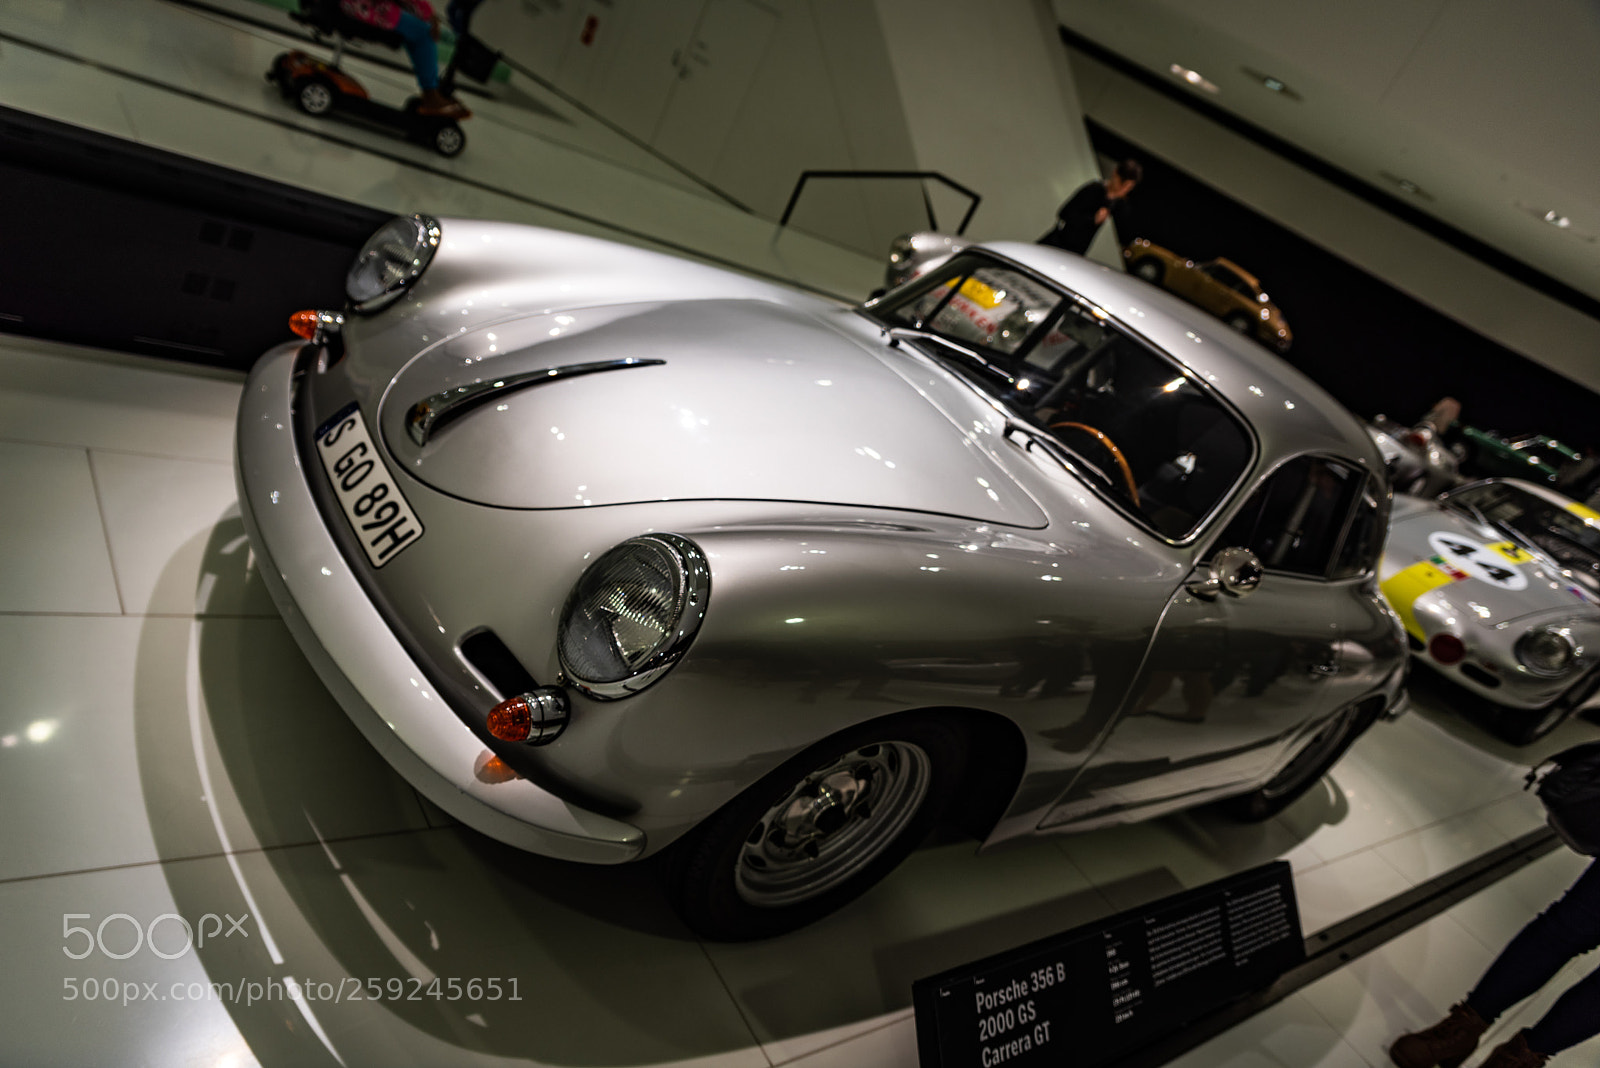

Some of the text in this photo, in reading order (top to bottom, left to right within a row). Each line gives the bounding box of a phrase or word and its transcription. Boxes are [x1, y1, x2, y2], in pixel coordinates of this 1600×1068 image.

[323, 418, 415, 560] S GO 89H
[1438, 539, 1516, 583] 44
[976, 961, 1066, 1014] Porsche 356 B
[979, 999, 1036, 1041] 2000 GS
[981, 1021, 1051, 1068] Carrera GT
